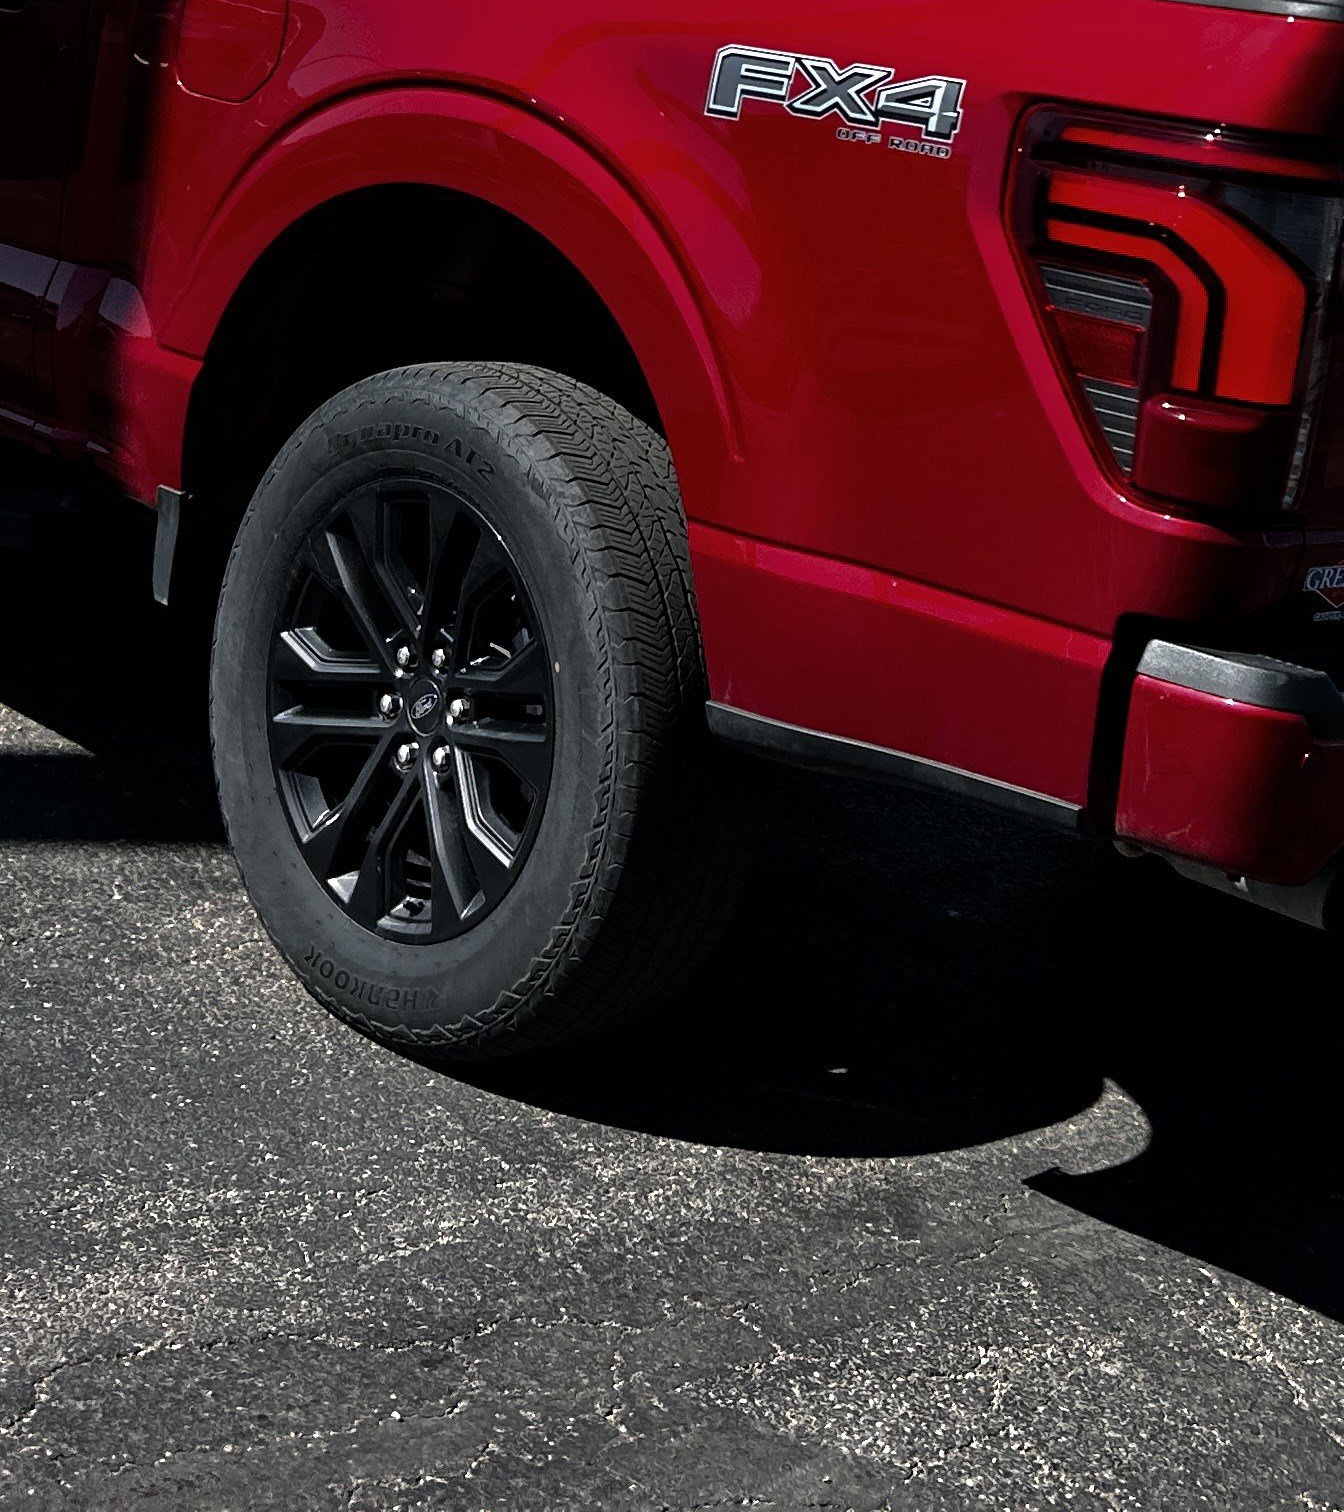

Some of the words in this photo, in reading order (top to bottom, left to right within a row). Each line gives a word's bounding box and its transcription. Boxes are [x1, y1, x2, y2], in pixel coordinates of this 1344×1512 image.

[704, 44, 966, 143] FX4
[836, 127, 881, 144] OFF
[888, 137, 951, 159] ROAD
